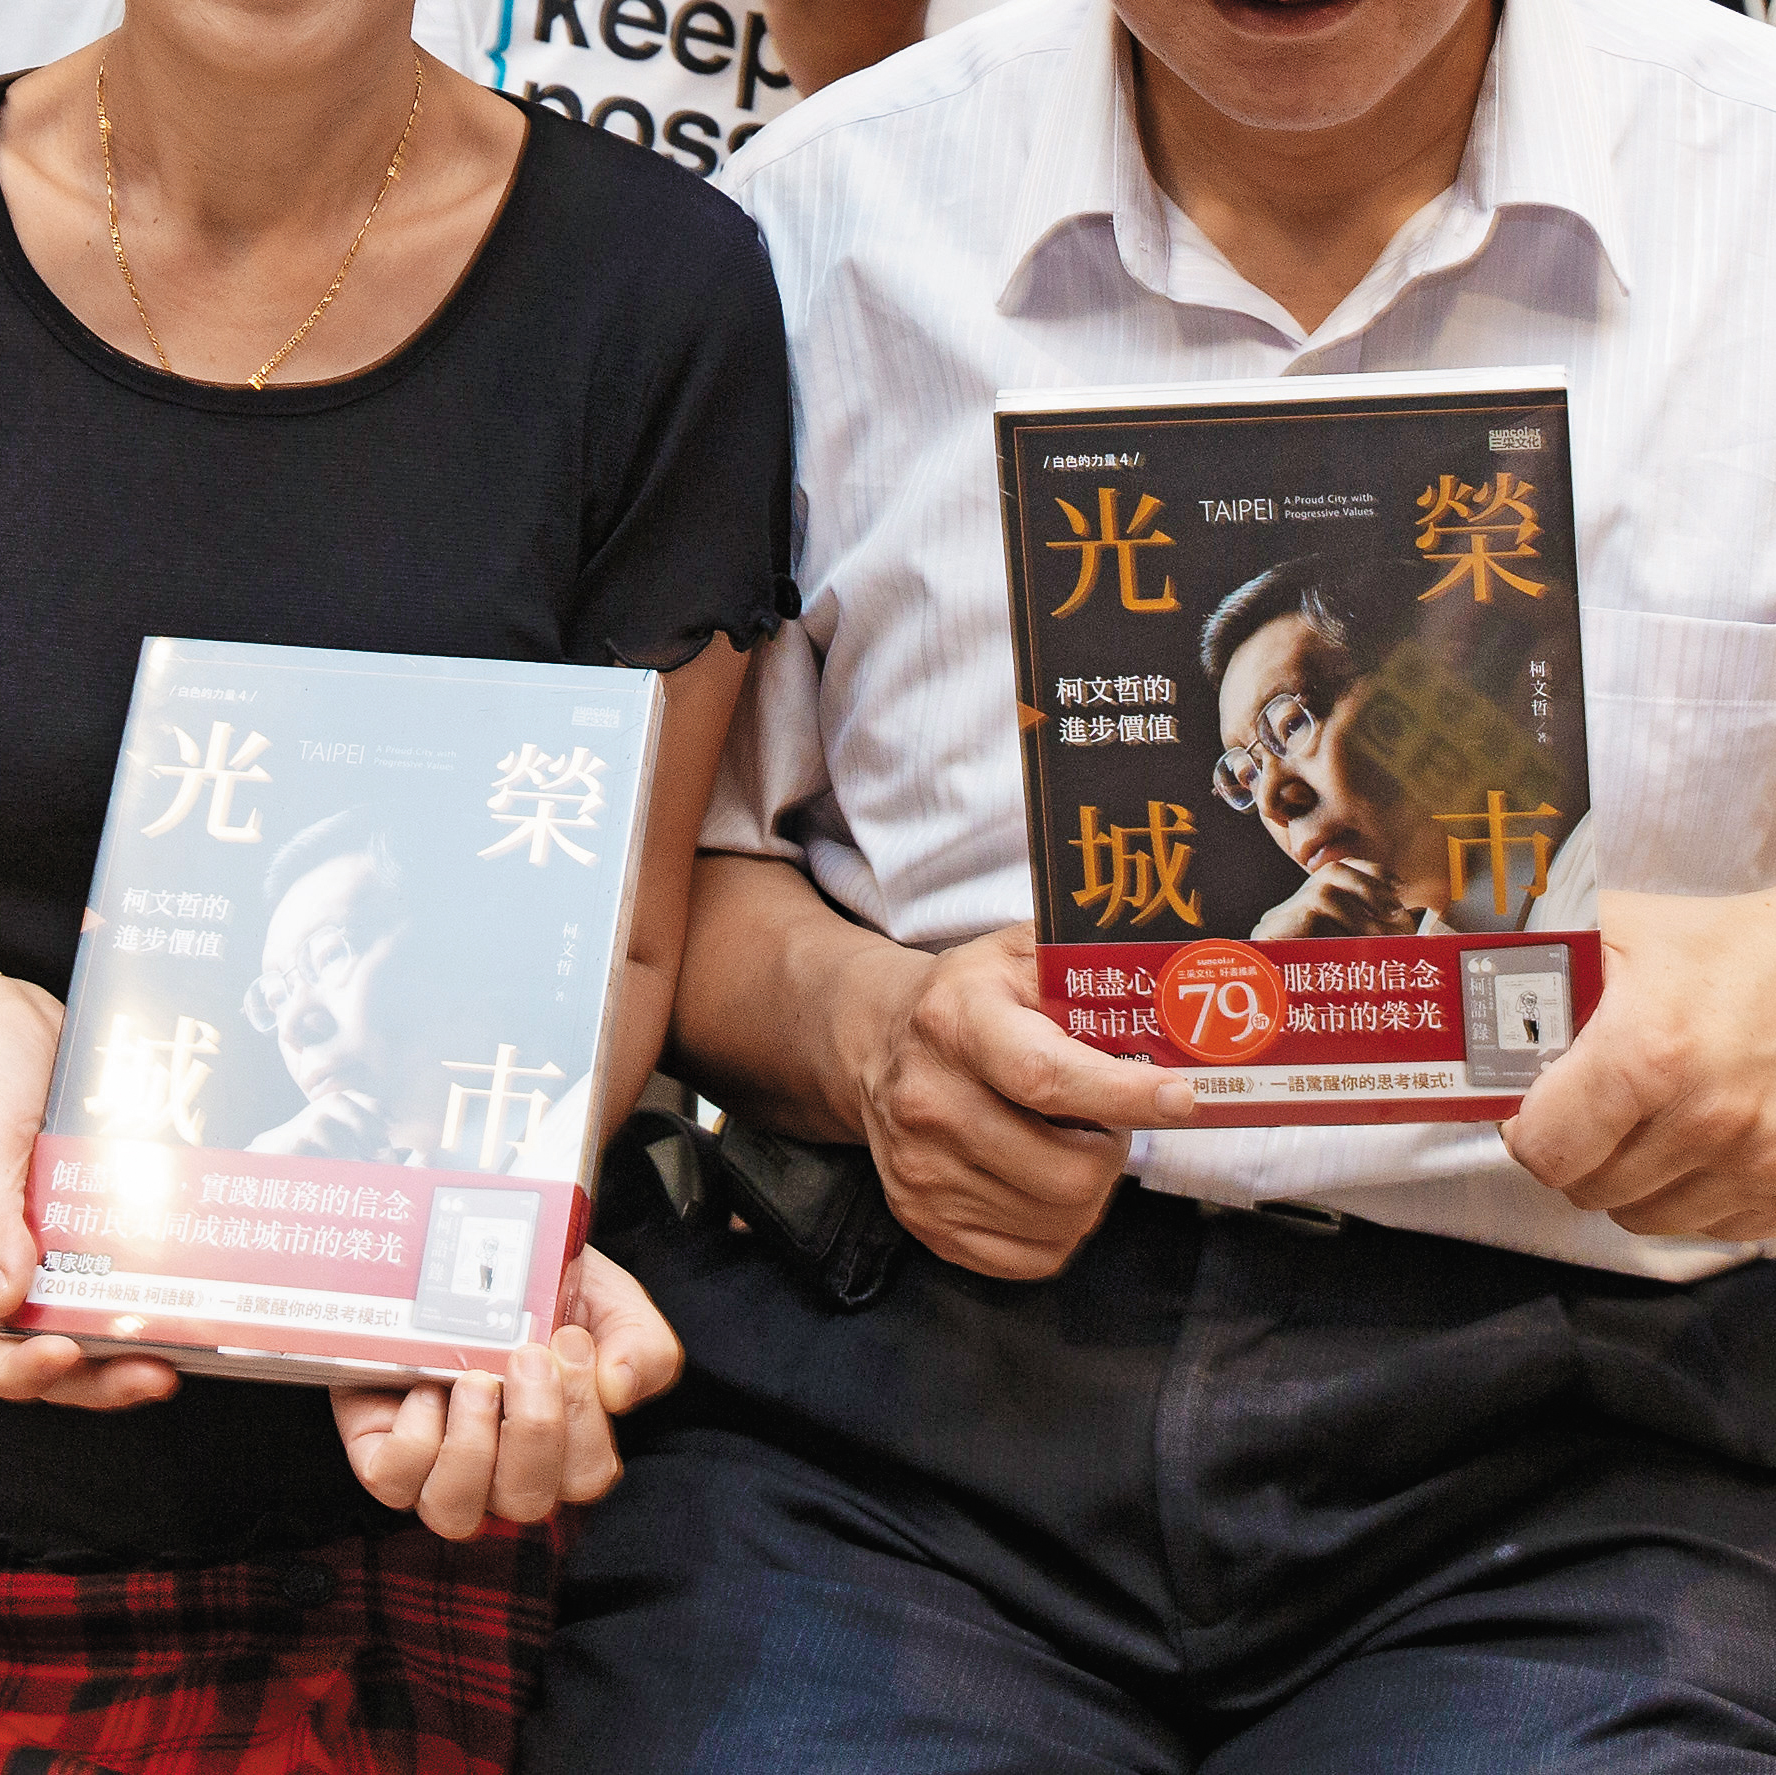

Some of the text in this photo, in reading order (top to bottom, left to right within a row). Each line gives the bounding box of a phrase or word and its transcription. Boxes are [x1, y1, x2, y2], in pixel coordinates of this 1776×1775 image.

[1489, 426, 1541, 438] suncolor
[1489, 437, 1542, 450] 三采文化
[1285, 506, 1374, 520] Progressive Values
[1294, 495, 1324, 505] Proud
[1328, 494, 1347, 506] City
[1351, 493, 1373, 503] with
[1046, 472, 1550, 619] 光 TAIPEI 榮
[1055, 674, 1172, 707] 柯文哲的
[1058, 712, 1176, 744] 進步價值
[385, 745, 412, 757] Proud
[140, 721, 608, 867] 光 TAIPEI 榮
[1068, 790, 1563, 928] 城 市
[121, 887, 230, 923] 柯文哲的
[111, 923, 225, 960] 進步價值
[1178, 981, 1259, 1045] 79
[441, 1043, 568, 1170] 市
[51, 1158, 413, 1222] 傾盡，實踐服務的信念
[43, 1250, 113, 1275] 獨家收錄
